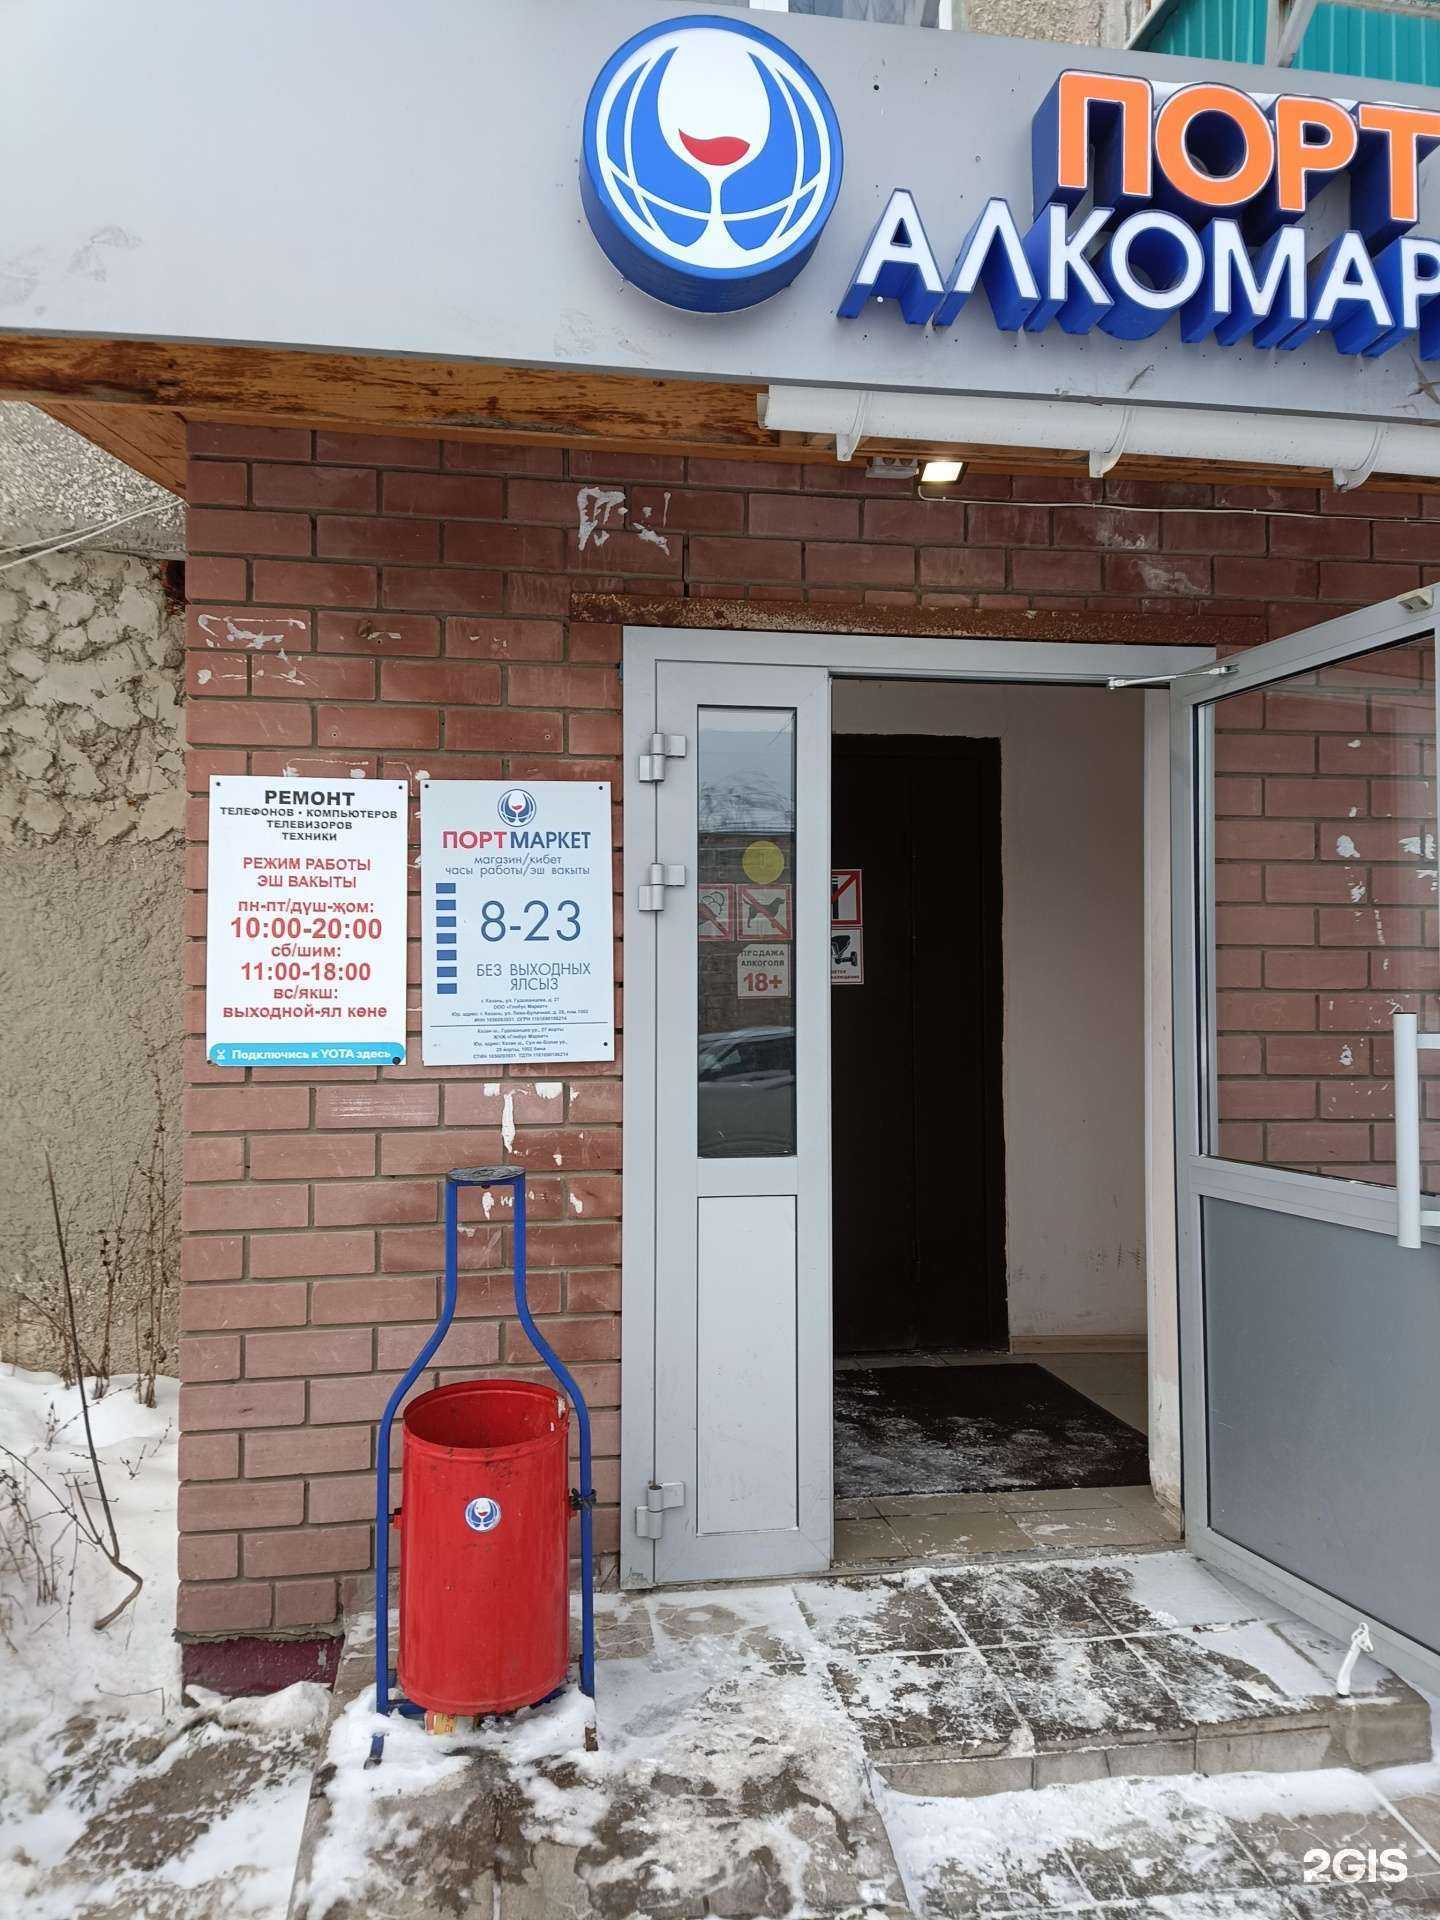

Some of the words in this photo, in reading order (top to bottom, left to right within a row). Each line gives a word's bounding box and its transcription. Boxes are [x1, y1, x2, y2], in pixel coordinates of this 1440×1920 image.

[1057, 68, 1440, 224] ПОРТ
[854, 187, 1440, 330] АЛКОМАР
[264, 790, 355, 806] РЕМОНТ
[220, 807, 294, 817] ТЕЛЕФОНОВ
[306, 808, 397, 819] КОМПЬЮТЕРОВ
[267, 820, 353, 830] ТЕЛЕВИЗОРОВ
[282, 832, 337, 841] ТЕХНИКИ
[243, 857, 300, 870] РЕЖИМ
[305, 858, 371, 871] РАБОТЫ
[474, 853, 562, 865] магазин/кибет
[445, 866, 473, 875] часы
[480, 864, 544, 877] работы/эш
[552, 866, 590, 875] вакыты
[257, 875, 283, 887] ЭШ
[288, 876, 356, 888] ВАКЫТЫ
[231, 917, 382, 939] 10:00-20:00
[481, 900, 581, 942] 8-23
[271, 943, 341, 957] сб/шим:
[476, 964, 502, 977] БЕЗ
[510, 962, 591, 976] ВЫХОДНЫХ
[741, 959, 784, 967] АЛКОГОЛЯ
[241, 962, 371, 981] 11:00-18:00
[510, 978, 559, 991] ЯЛСЫЗ
[744, 972, 782, 992] 18+
[274, 985, 338, 999] вс/якш:
[223, 1004, 341, 1019] выходной-ял
[232, 1049, 309, 1060] Подключись
[311, 1051, 319, 1059] к
[320, 1050, 352, 1058] YOTA
[357, 1050, 390, 1059] здесь
